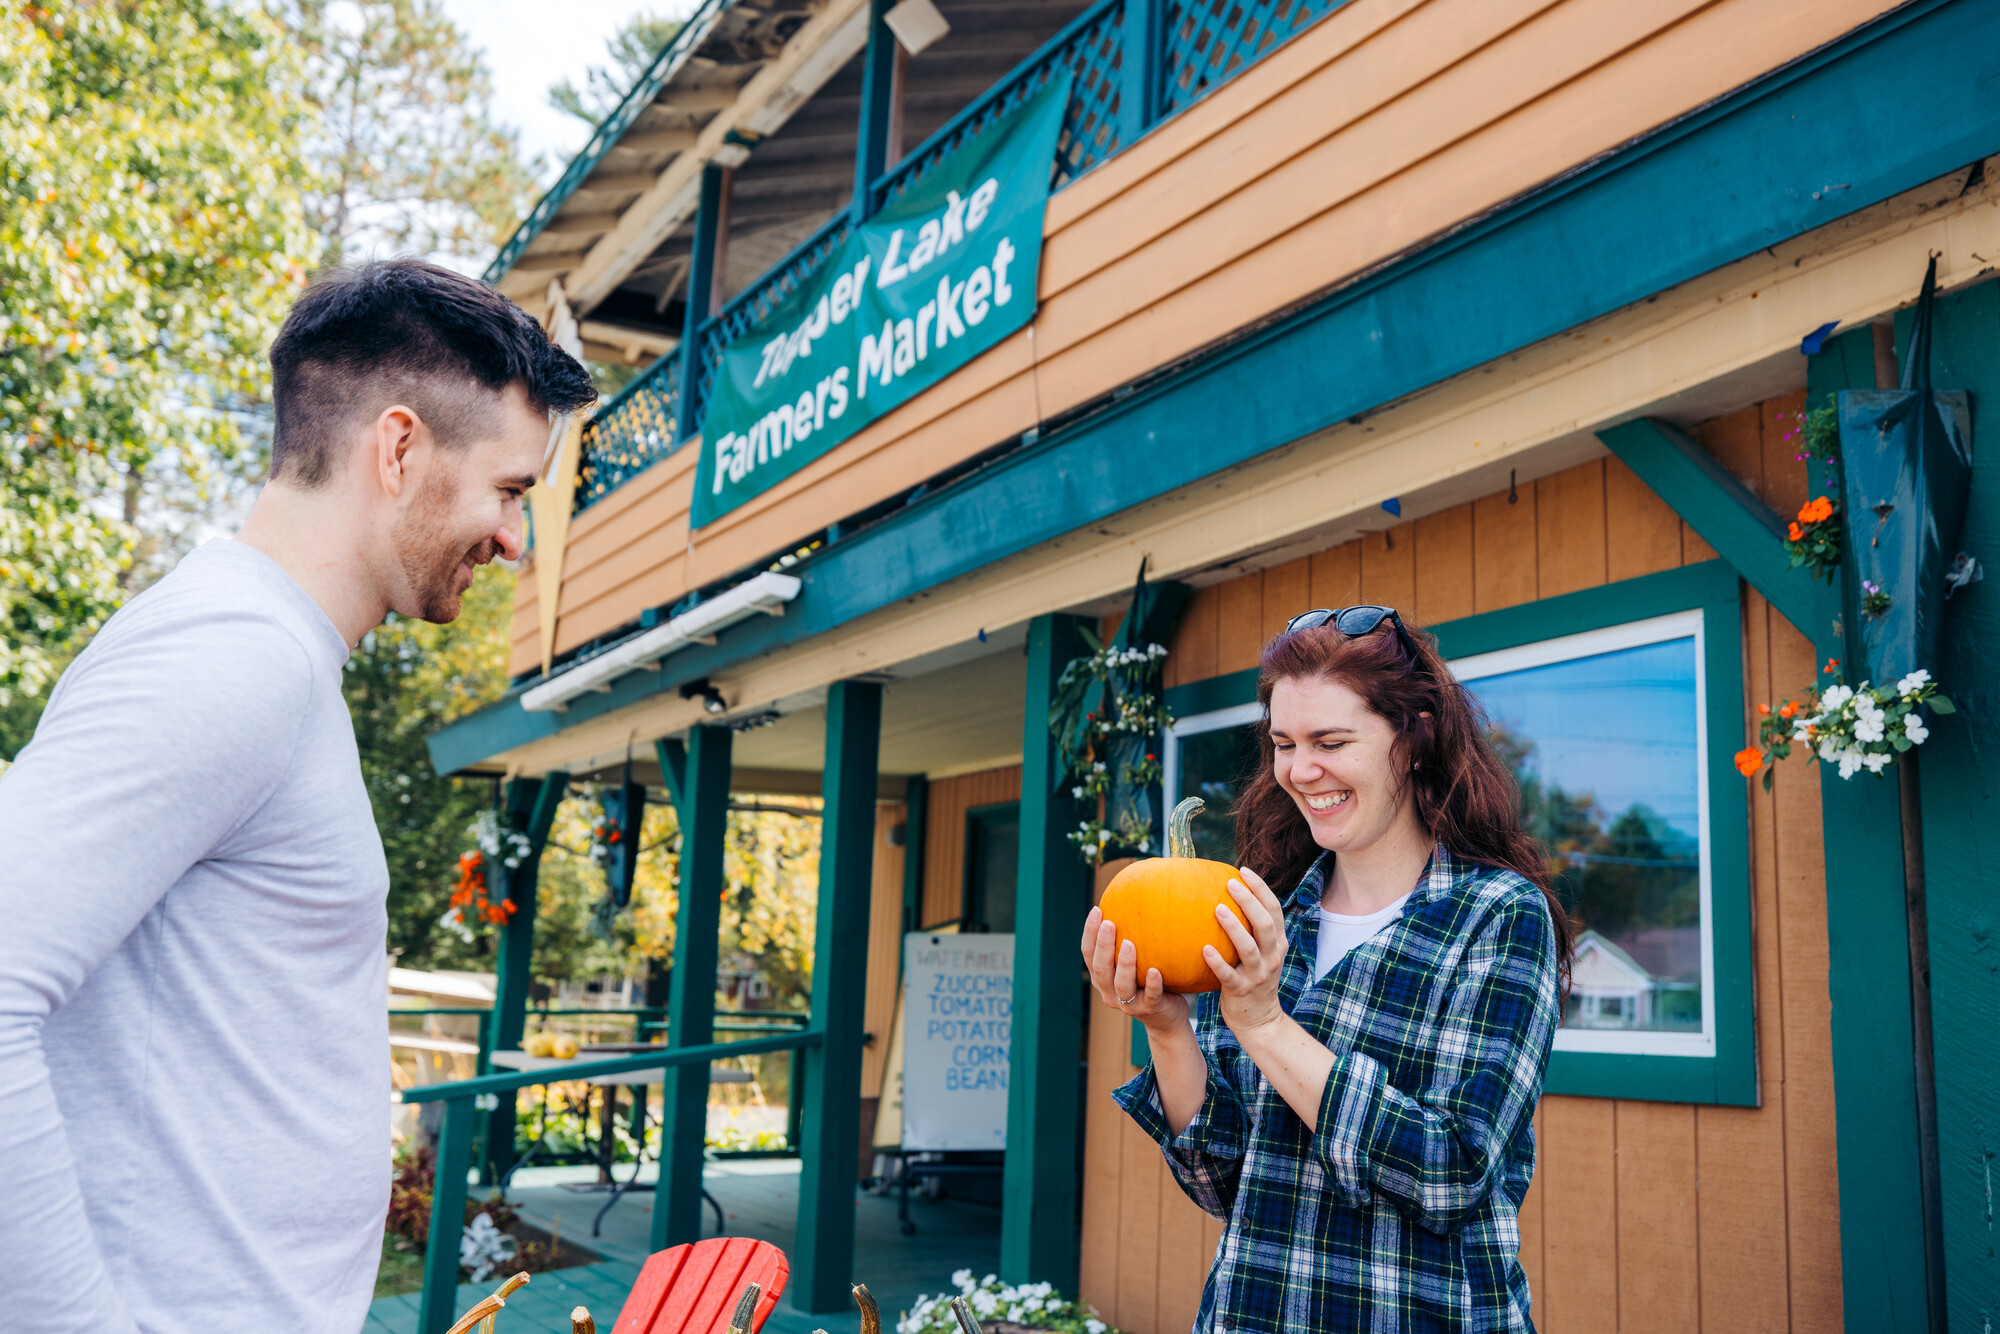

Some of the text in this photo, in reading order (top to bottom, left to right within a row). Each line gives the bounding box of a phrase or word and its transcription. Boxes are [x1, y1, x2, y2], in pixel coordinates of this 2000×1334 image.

[876, 178, 998, 289] Lake
[712, 236, 1015, 495] Farmers Market
[927, 994, 1012, 1017] TOMATO
[927, 1019, 1011, 1041] POTATO
[952, 1044, 1011, 1066] CORN
[946, 1067, 1006, 1090] BEAN
